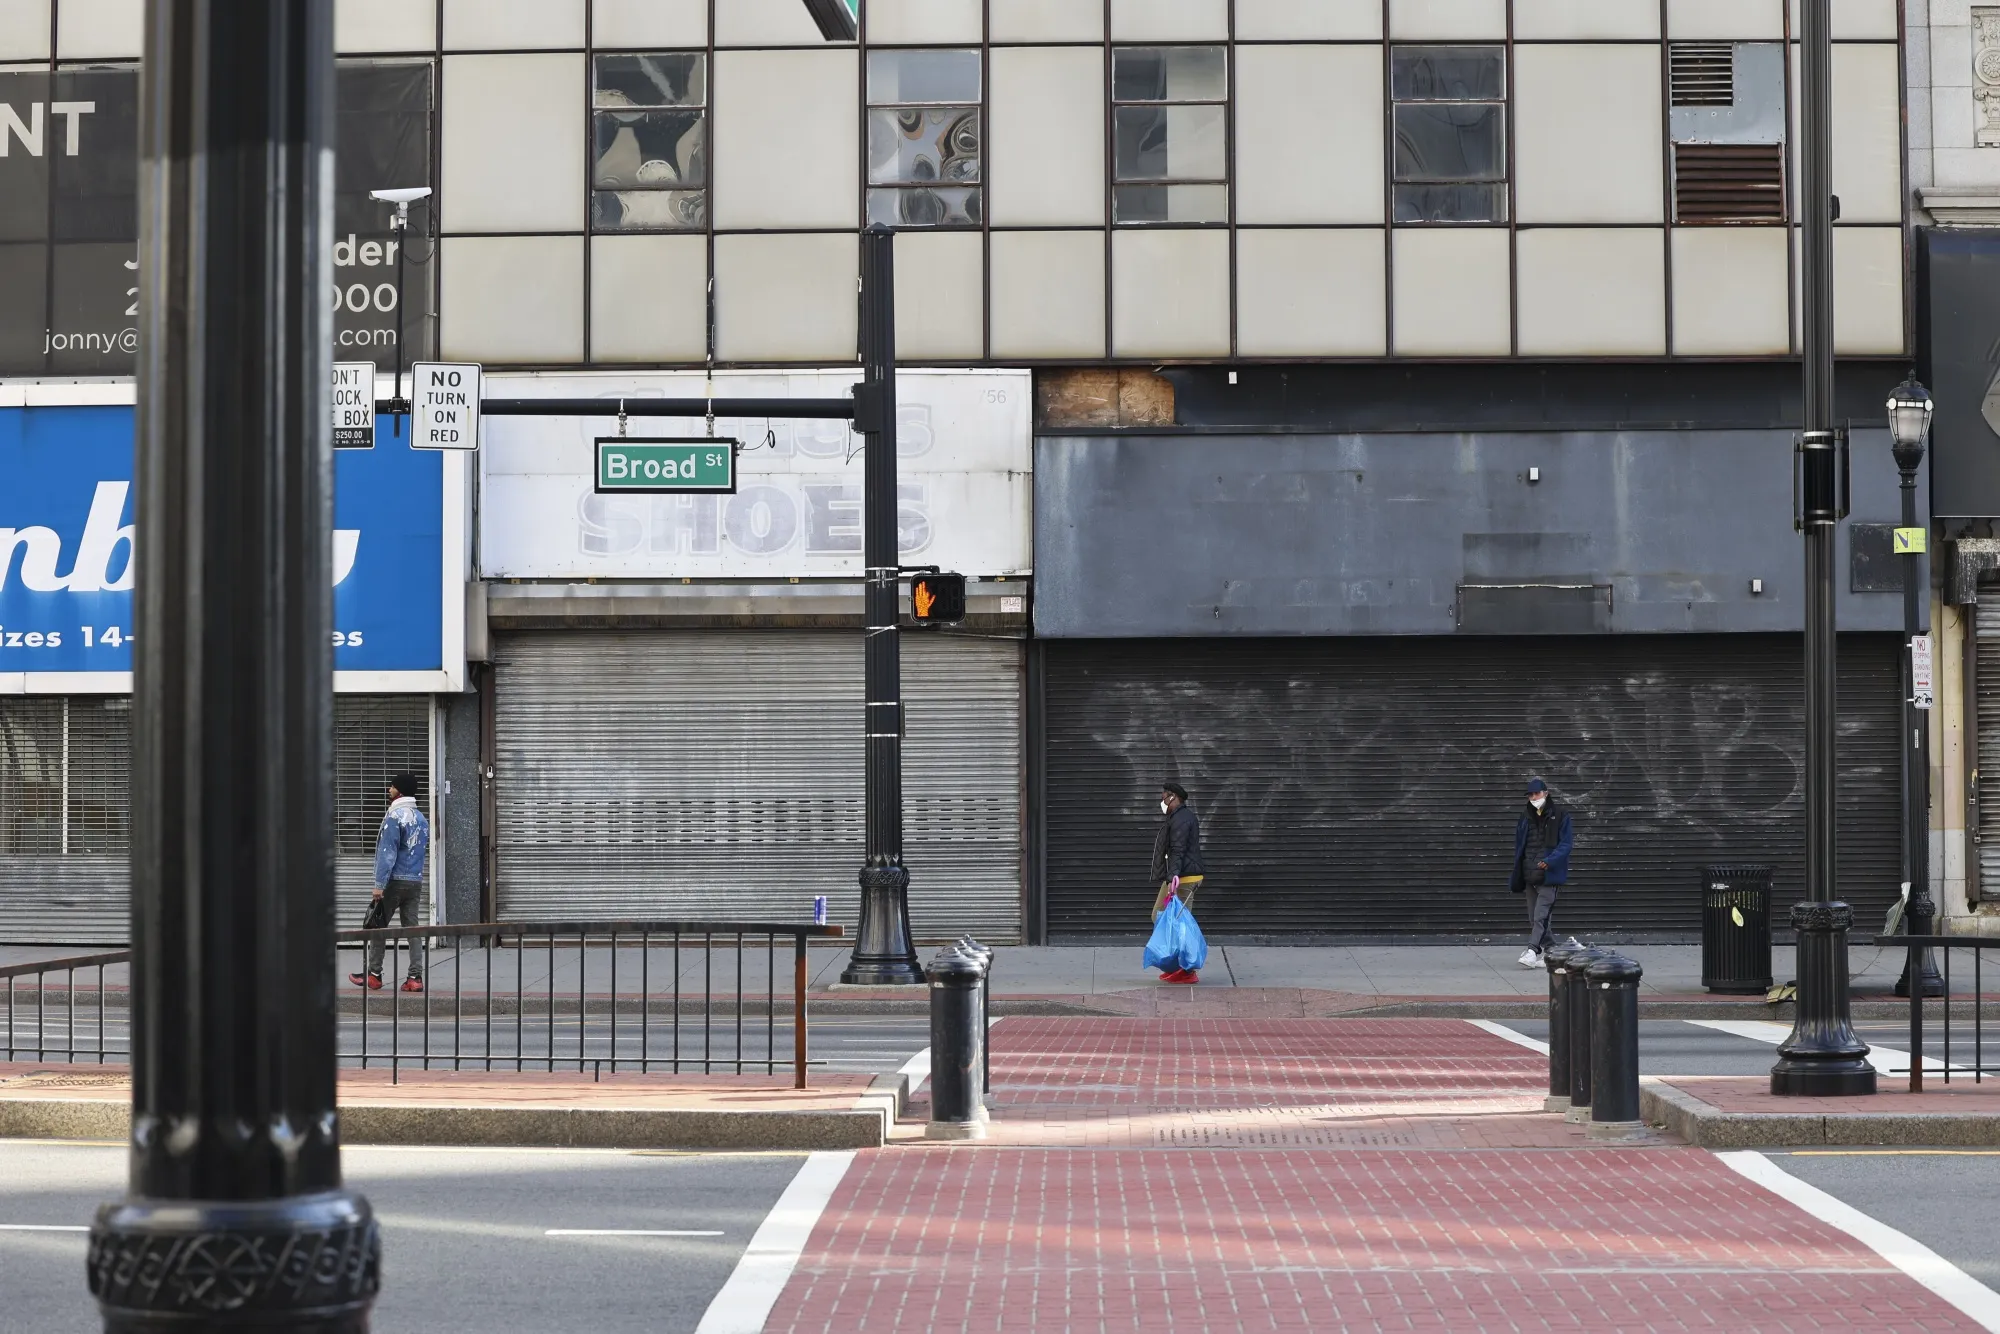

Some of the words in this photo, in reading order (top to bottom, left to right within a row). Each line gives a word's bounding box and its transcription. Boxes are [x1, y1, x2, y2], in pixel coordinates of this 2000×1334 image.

[0, 101, 96, 157] NT
[431, 371, 462, 387] NO
[332, 389, 362, 406] OCK
[427, 391, 466, 406] TURN
[344, 409, 370, 426] BOX
[434, 410, 456, 424] ON
[335, 430, 363, 439] $250.00
[430, 429, 459, 443] RED
[607, 453, 696, 479] Broad
[705, 453, 723, 467] St
[577, 483, 936, 557] SHOES
[1916, 639, 1926, 652] NO
